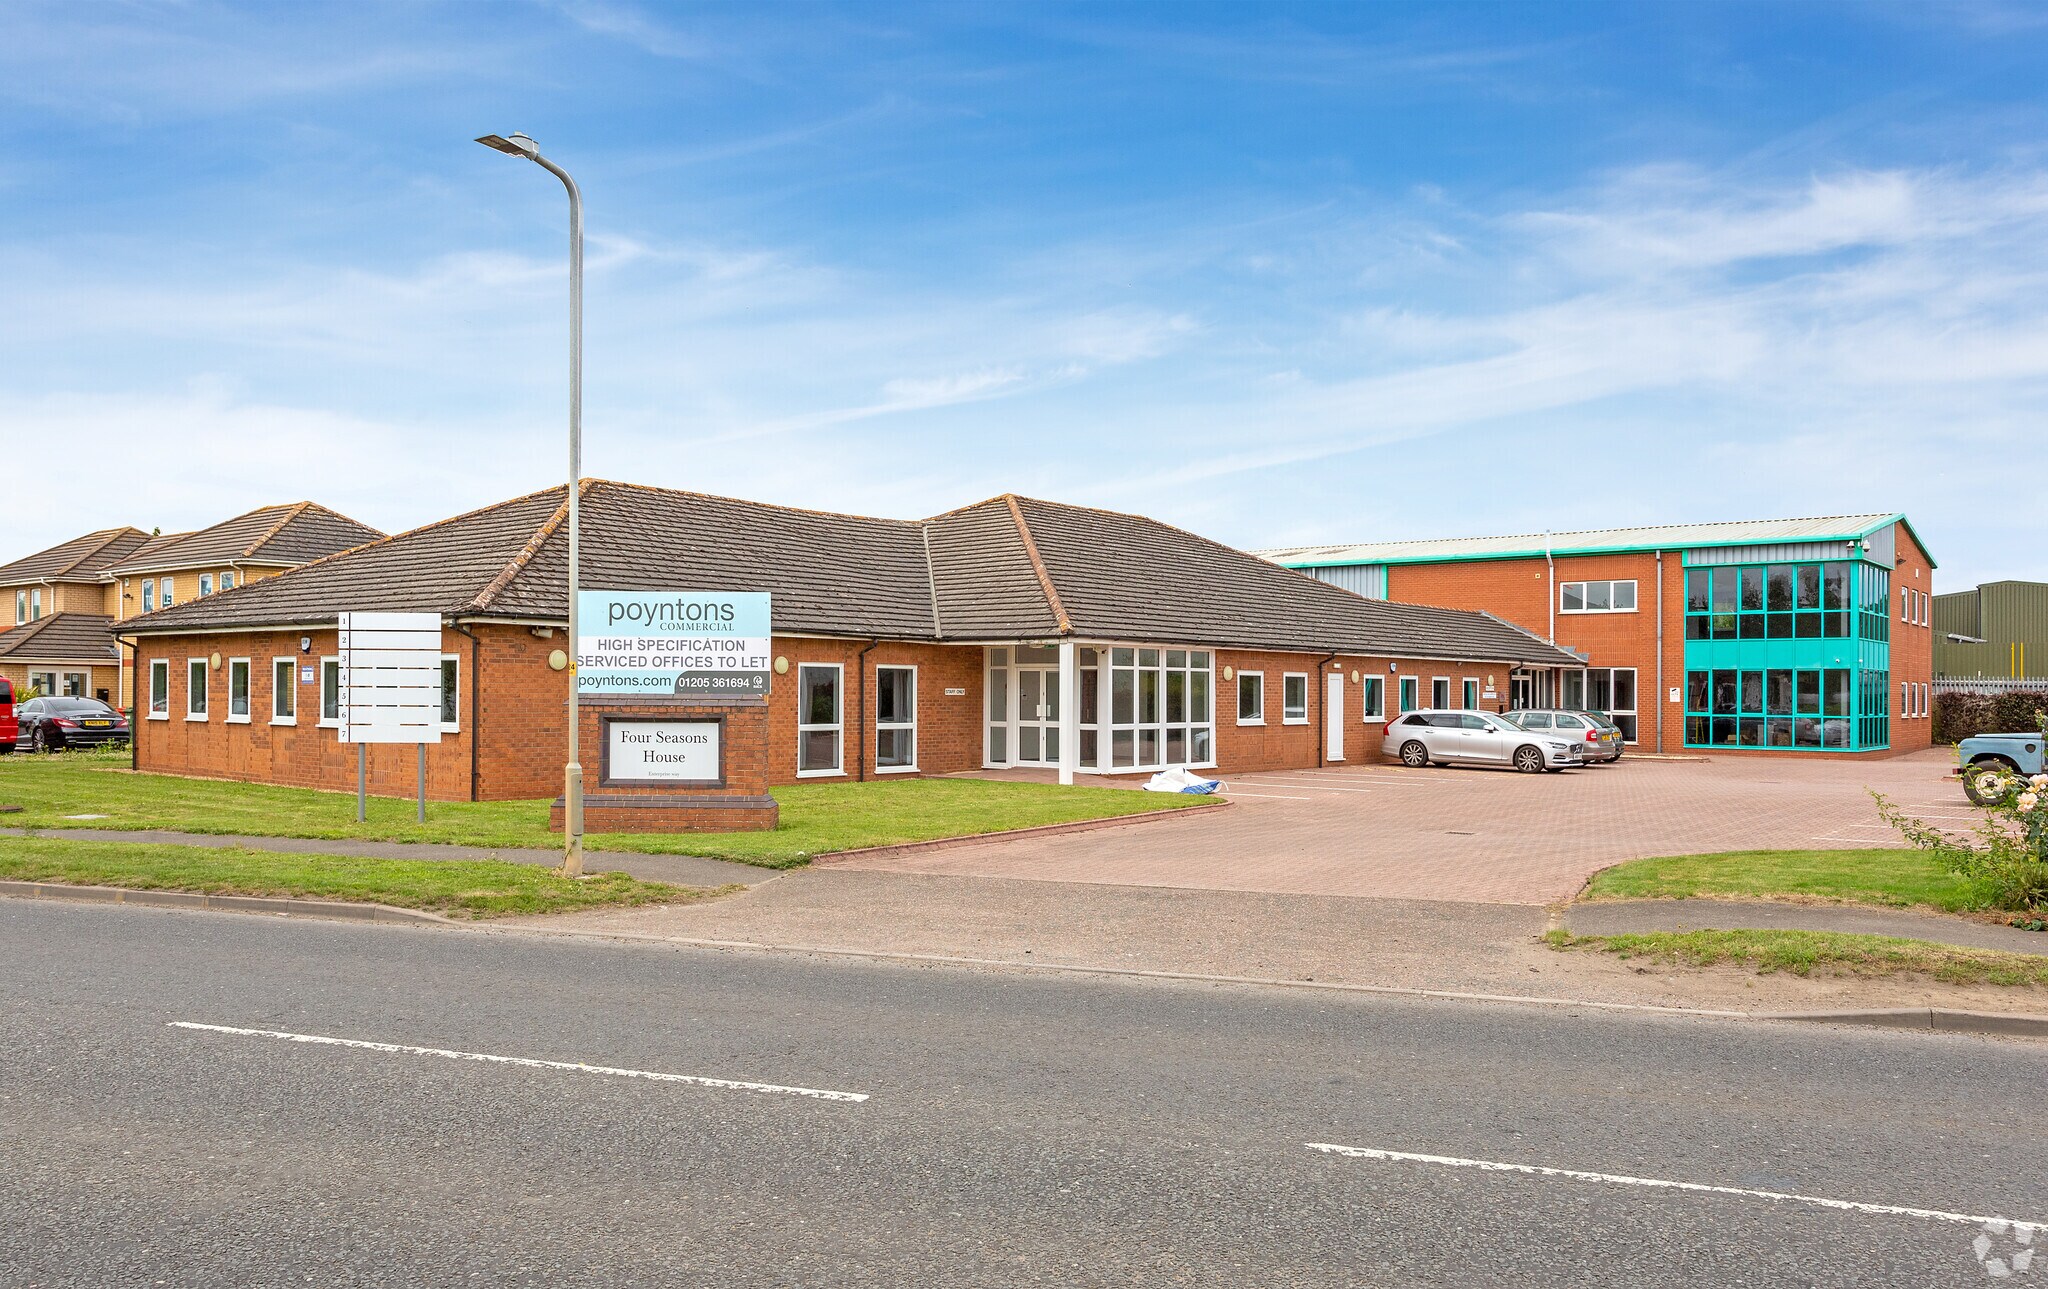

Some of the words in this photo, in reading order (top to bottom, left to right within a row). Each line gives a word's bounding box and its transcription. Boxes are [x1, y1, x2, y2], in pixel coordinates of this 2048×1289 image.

[164, 594, 172, 604] LE
[608, 598, 735, 627] poyntons
[659, 622, 735, 631] COMMERCIAL
[597, 639, 633, 651] HIGH
[637, 639, 746, 651] SPECIFICATION
[577, 655, 648, 667] SERVICED
[652, 656, 713, 668] OFFICES
[717, 656, 737, 668] TO
[741, 656, 768, 668] LET
[578, 675, 671, 689] poyntons.com
[678, 677, 710, 688] 01205
[712, 677, 750, 688] 361694
[621, 730, 652, 744] Four
[655, 730, 708, 744] Seasons
[643, 750, 686, 763] House
